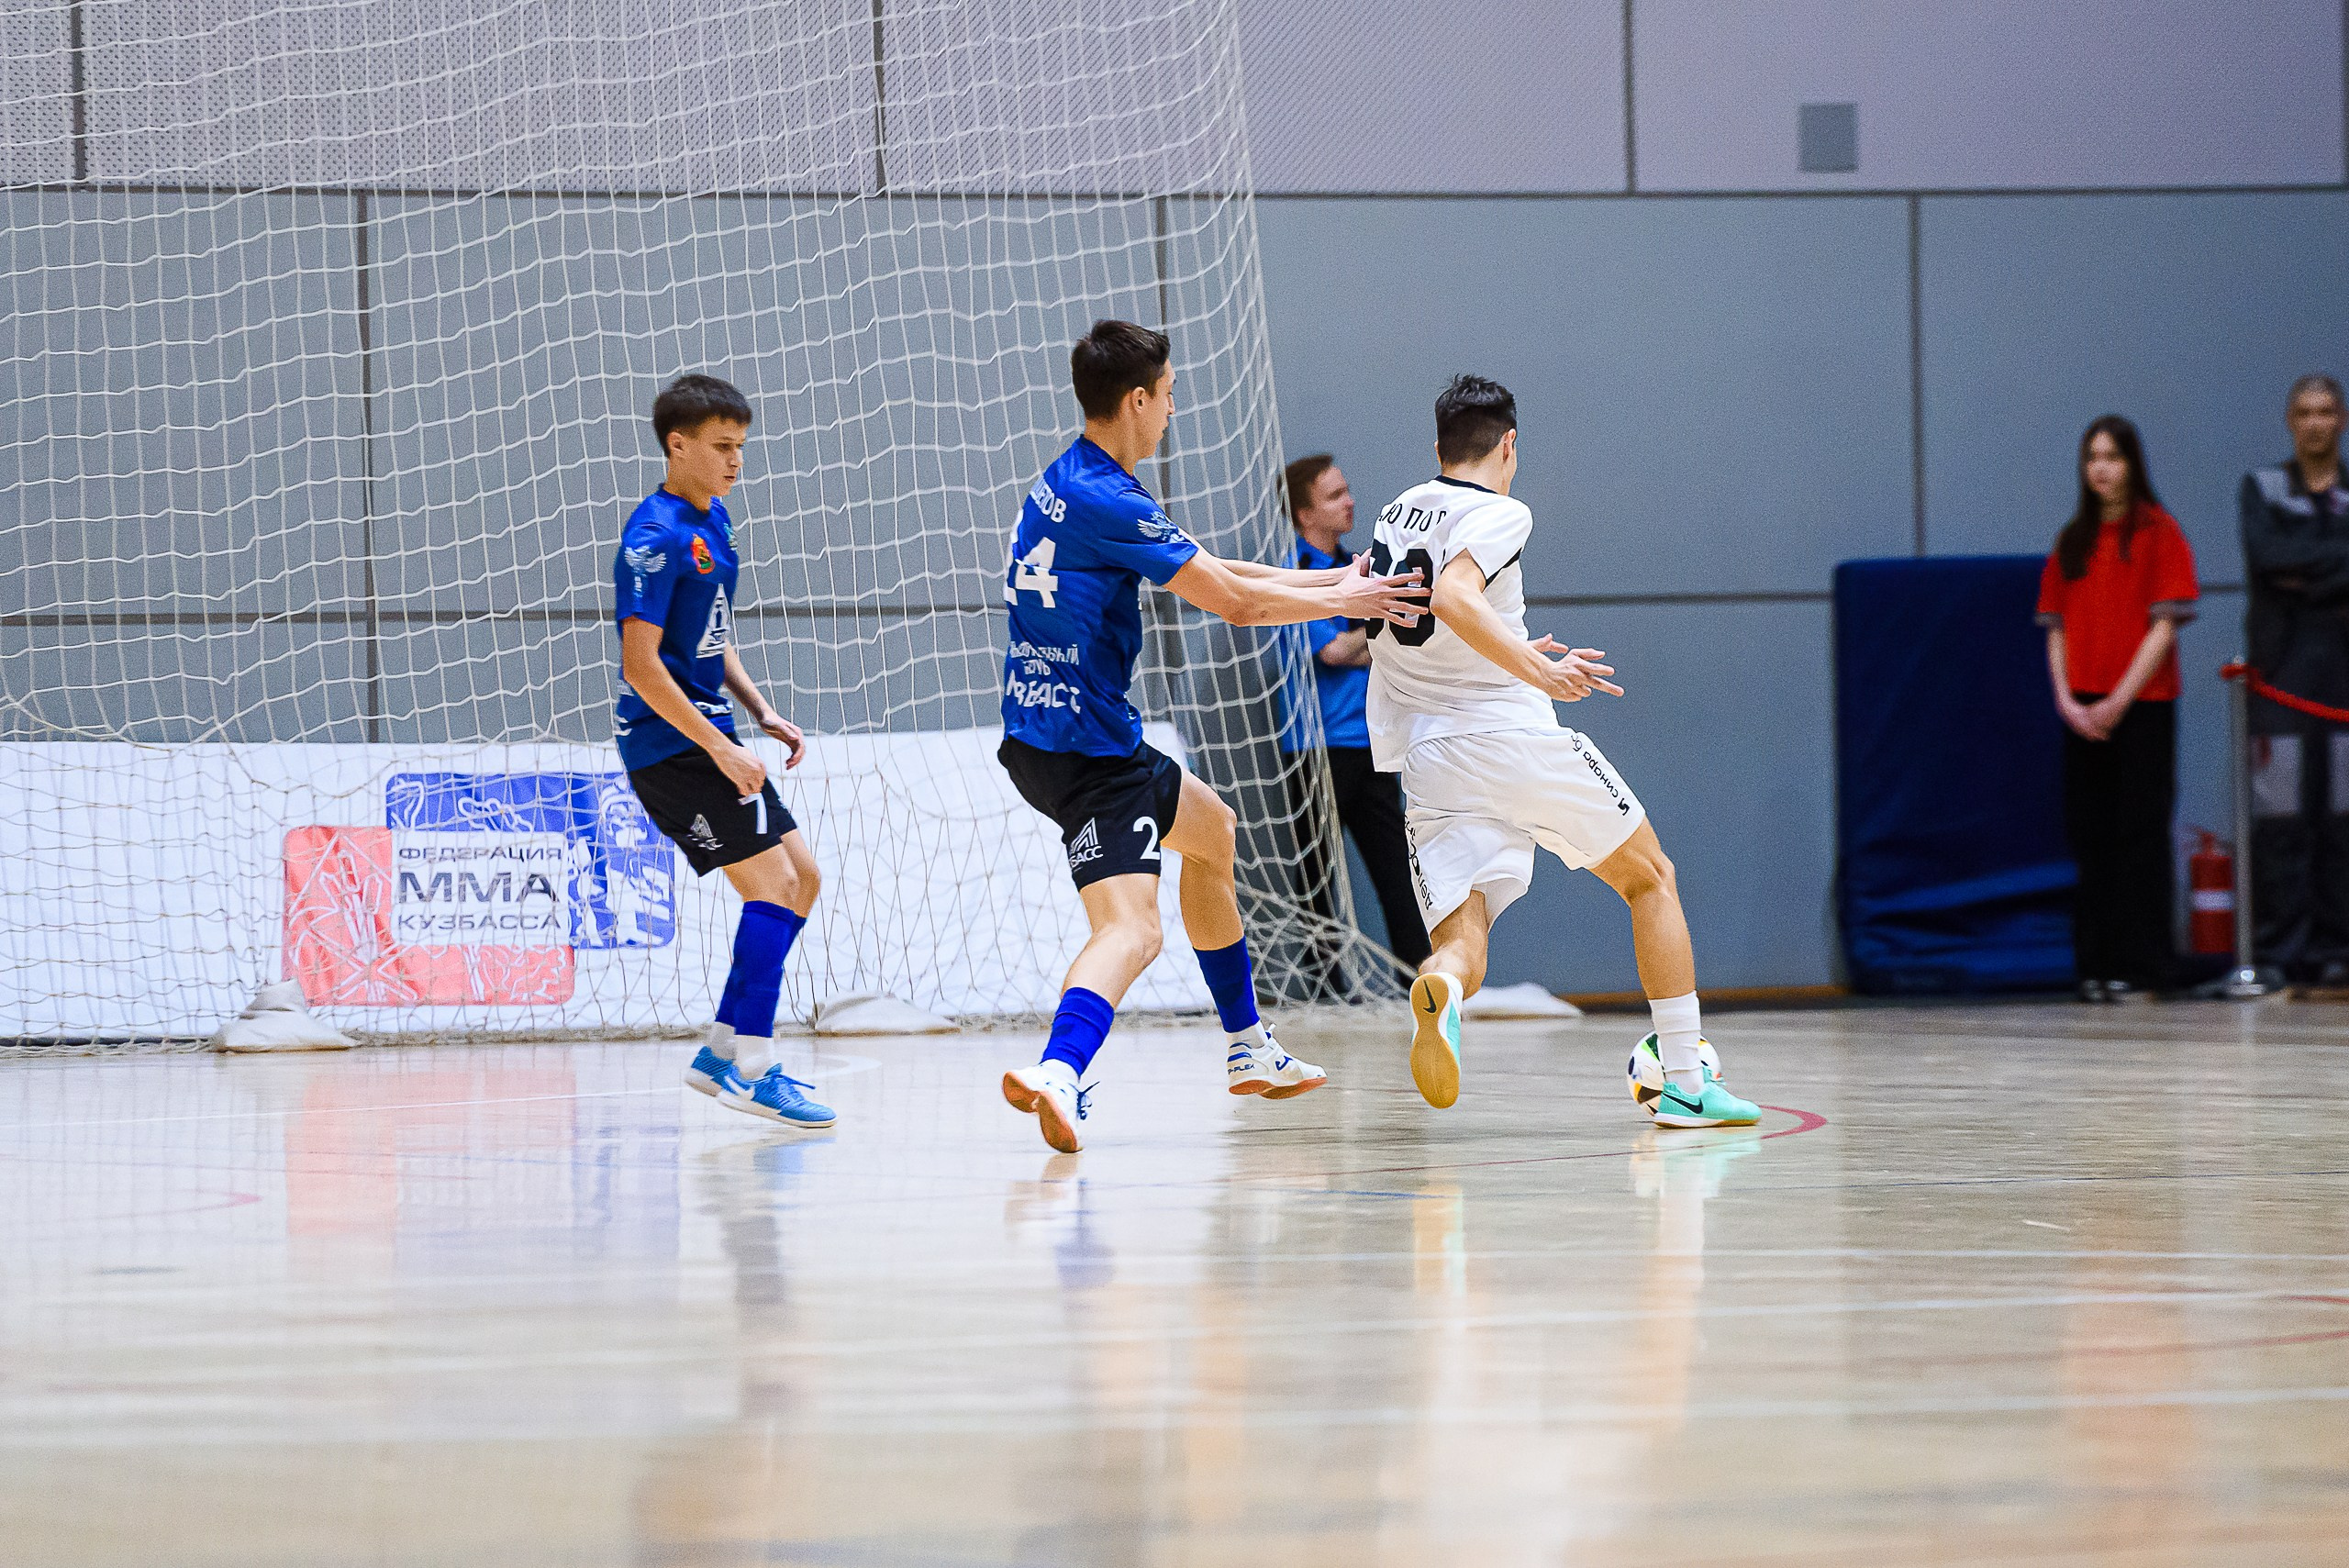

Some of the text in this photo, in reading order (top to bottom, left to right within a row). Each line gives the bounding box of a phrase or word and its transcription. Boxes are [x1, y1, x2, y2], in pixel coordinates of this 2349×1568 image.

[1583, 751, 1619, 798] синара
[738, 792, 768, 835] 7
[398, 847, 562, 862] ФЕДЕРАЦИЯ
[1069, 845, 1104, 868] БАСС
[398, 872, 560, 904] ММА
[398, 915, 562, 930] КУЗБАССА
